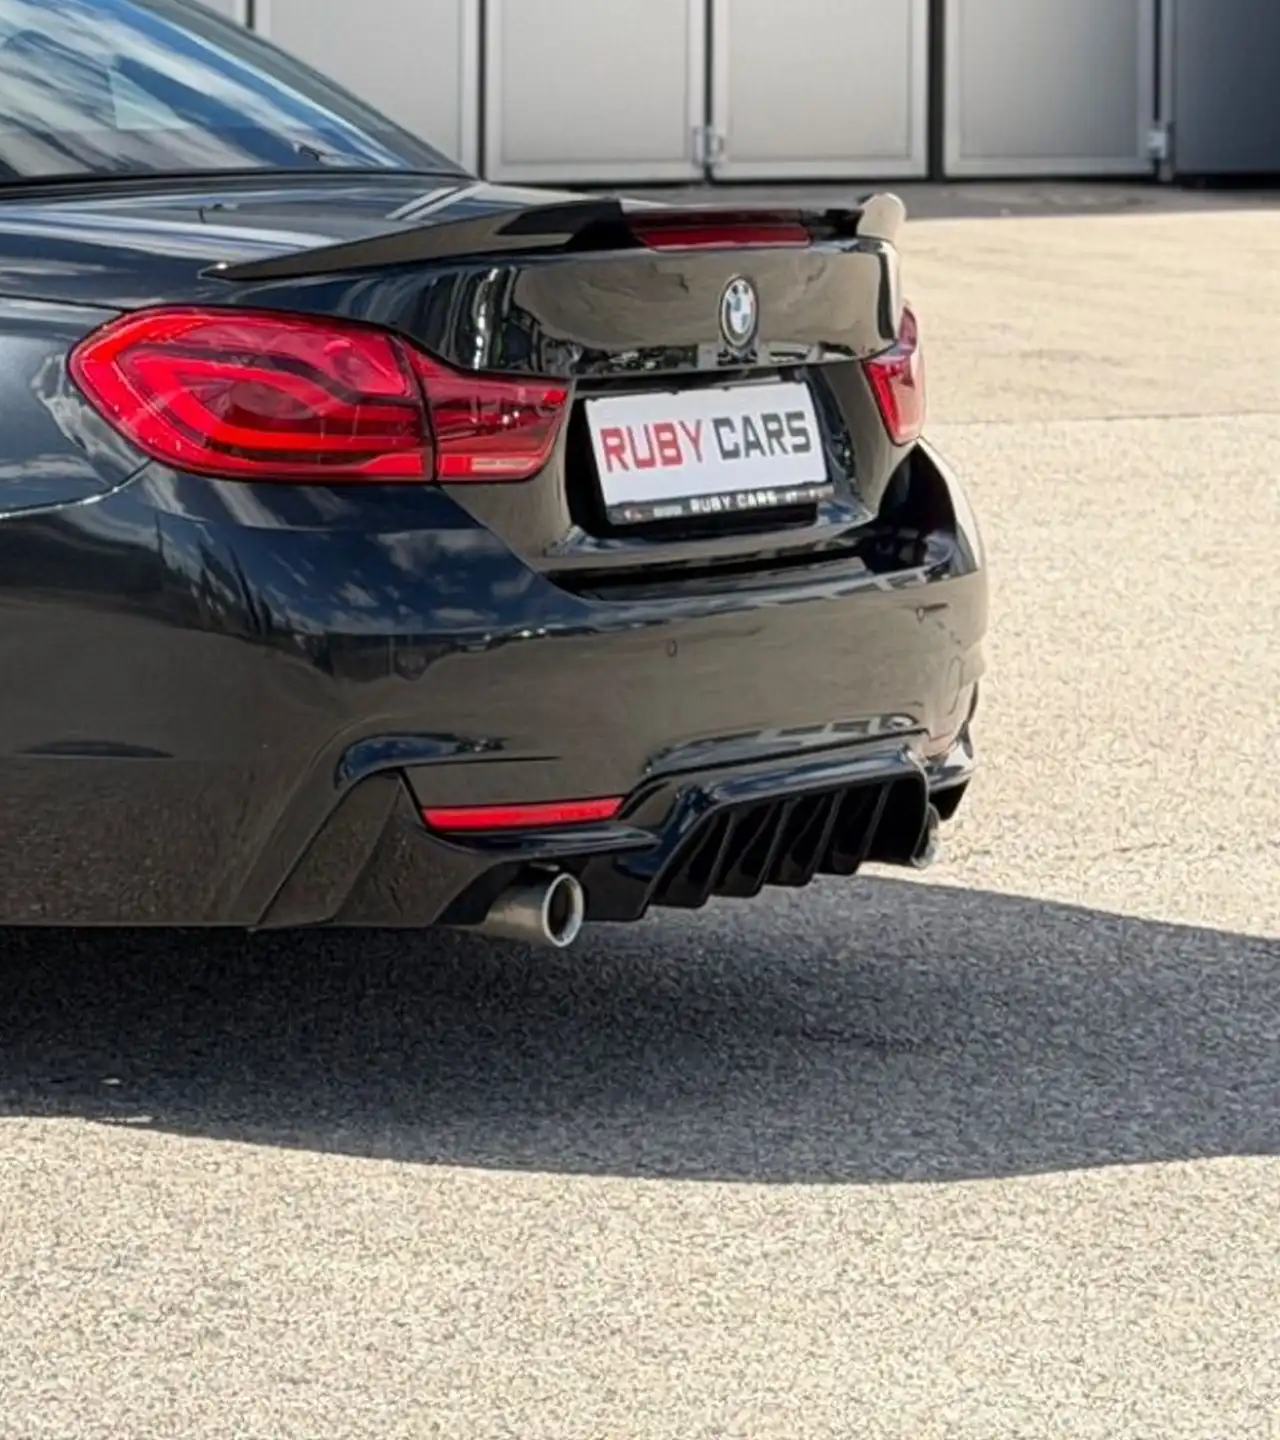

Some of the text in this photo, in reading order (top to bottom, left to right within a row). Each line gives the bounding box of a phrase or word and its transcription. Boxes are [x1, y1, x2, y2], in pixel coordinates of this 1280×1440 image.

[599, 410, 812, 473] RUBY CARS
[690, 496, 731, 513] RUBY
[736, 490, 778, 509] CARS
